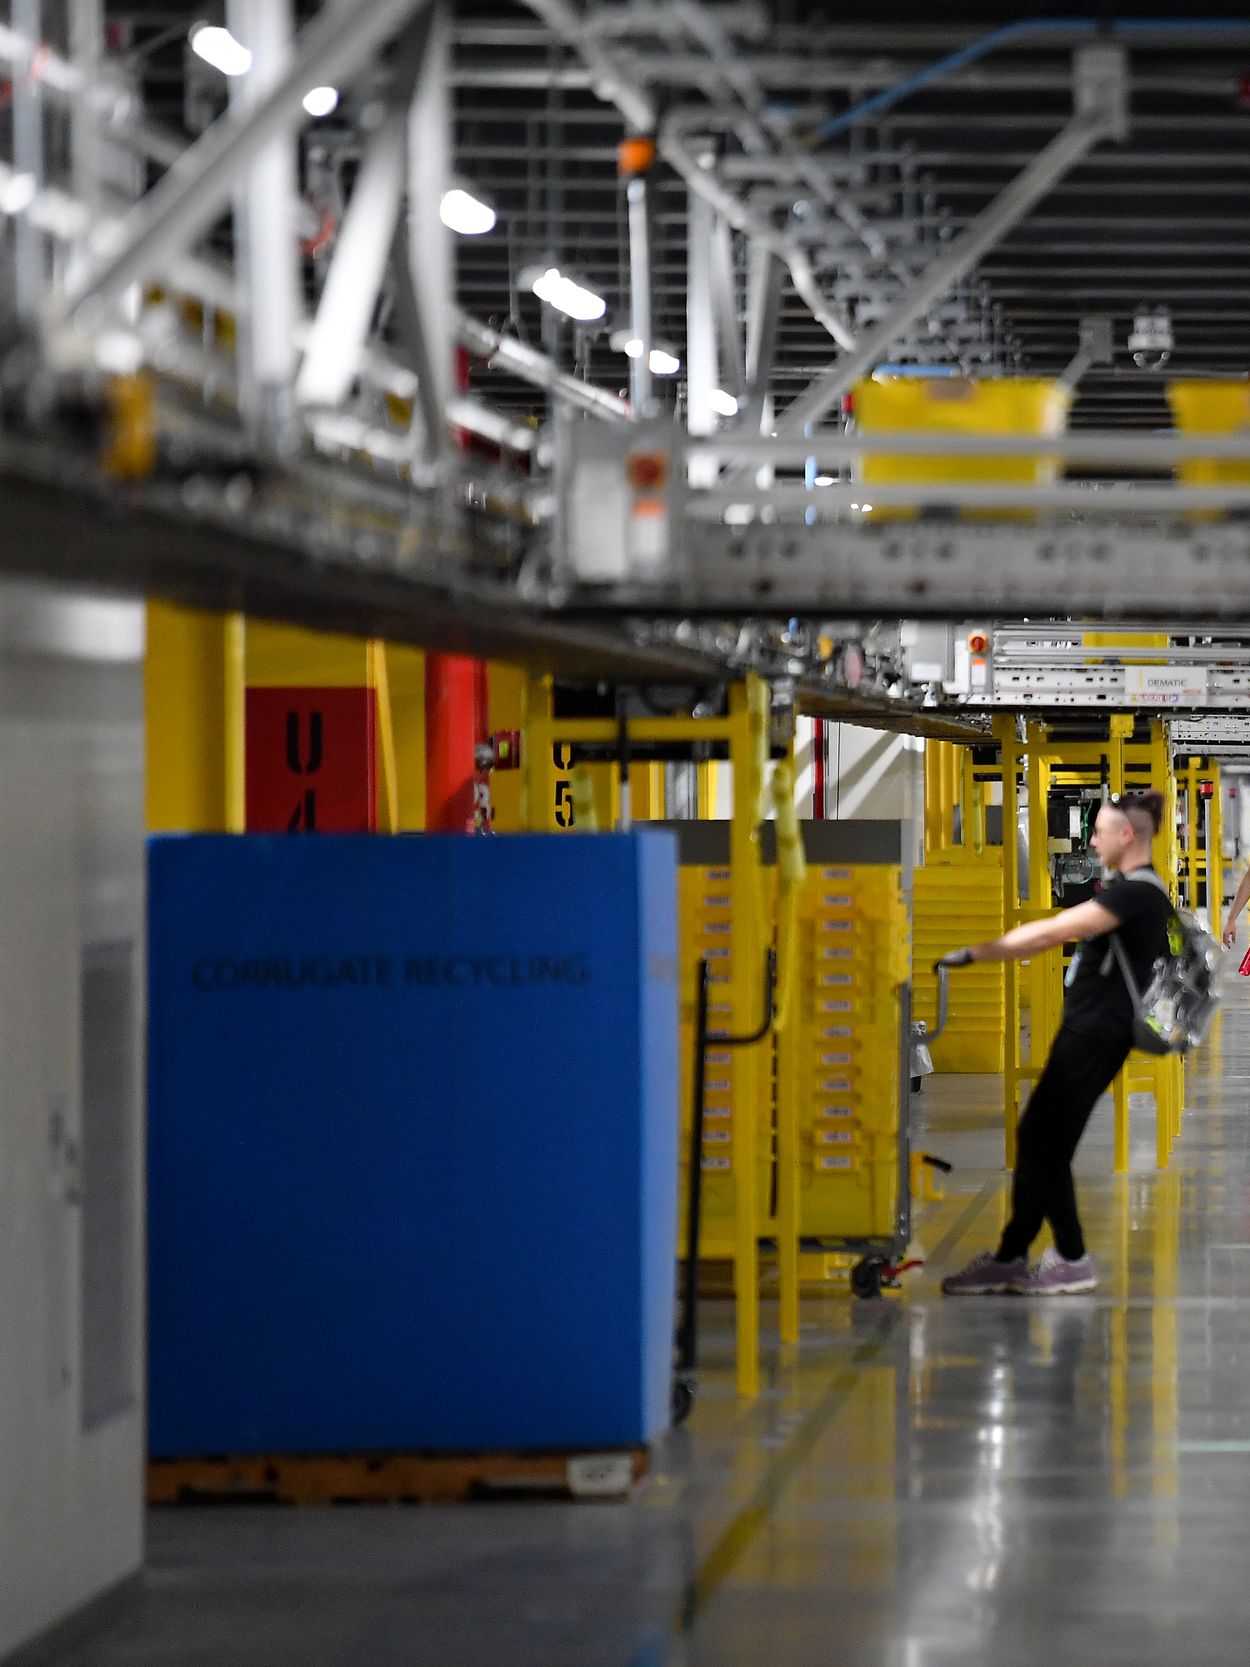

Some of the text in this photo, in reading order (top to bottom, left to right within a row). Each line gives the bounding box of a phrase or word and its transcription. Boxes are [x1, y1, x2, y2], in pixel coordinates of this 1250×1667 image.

[1147, 679, 1188, 687] DEMATIC
[191, 951, 590, 991] CORRUGATE RECYCLING
